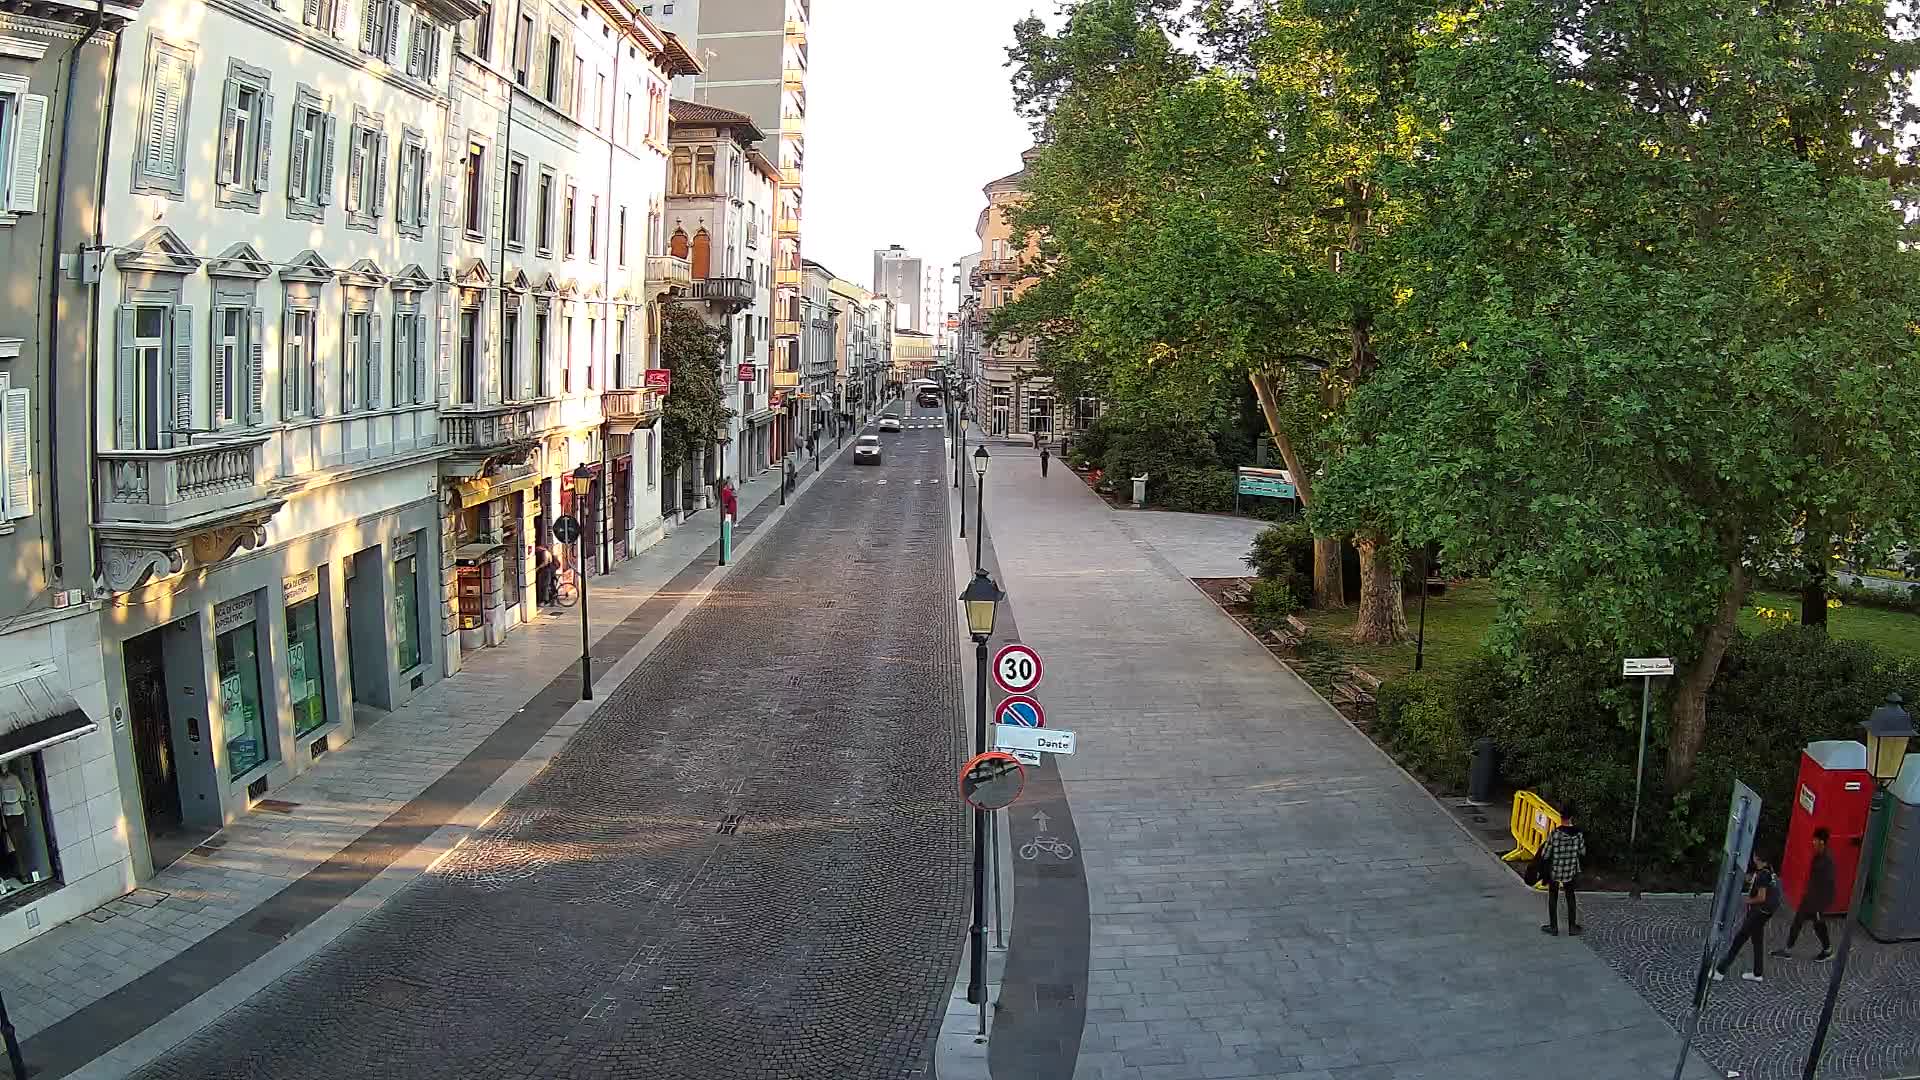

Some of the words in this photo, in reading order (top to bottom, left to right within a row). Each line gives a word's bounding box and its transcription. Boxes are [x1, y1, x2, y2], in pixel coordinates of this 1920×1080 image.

[216, 611, 242, 627] OPERATIVO
[1004, 658, 1032, 681] 30
[1038, 738, 1069, 749] Dante
